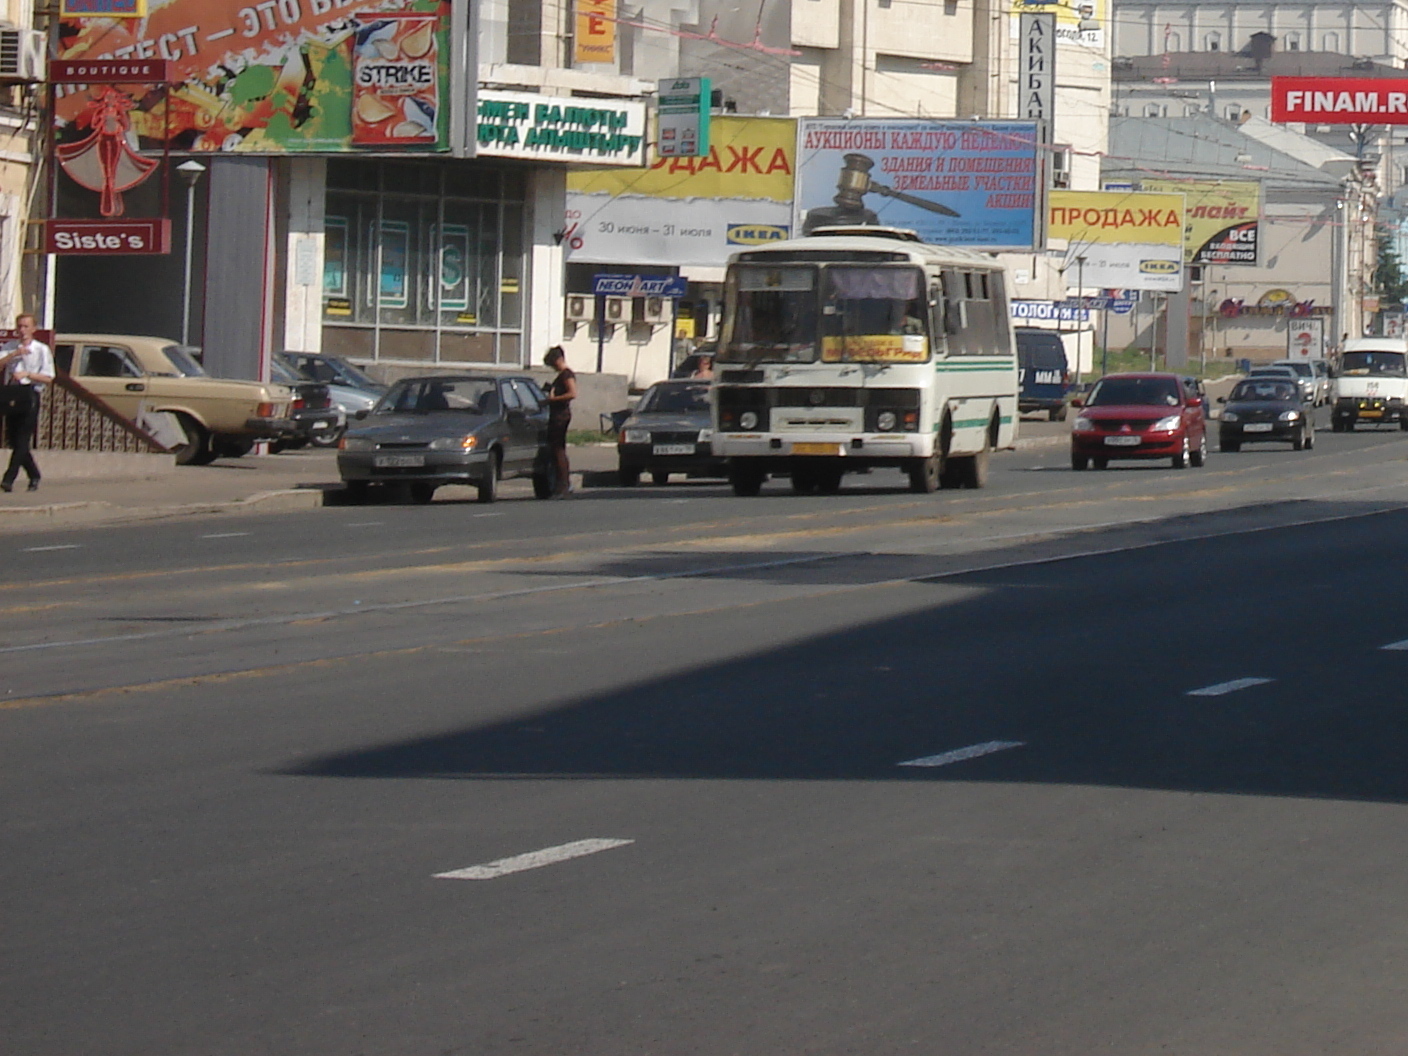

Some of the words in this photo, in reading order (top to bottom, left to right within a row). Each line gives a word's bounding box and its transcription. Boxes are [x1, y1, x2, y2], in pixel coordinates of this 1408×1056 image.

[66, 66, 150, 75] BOUTIQUE
[359, 65, 432, 87] STRIKE
[534, 104, 628, 128] ВАЛЮТЫ
[804, 130, 886, 150] АУКЦИОНЫ
[890, 131, 957, 151] КАЖДУЮ
[881, 156, 932, 174] ЗДАНИЯ
[935, 156, 946, 172] И
[893, 175, 970, 190] ЗЕМЕЛЬНЫЕ
[1050, 207, 1180, 229] ПРОДАЖА
[599, 222, 614, 233] 30
[617, 225, 649, 234] июня
[662, 224, 675, 236] 31
[679, 228, 712, 237] июля
[734, 229, 781, 240] IKEA
[1229, 229, 1256, 241] ВСЕ
[54, 231, 145, 251] Siste's
[1200, 251, 1256, 260] БЕСПЛАТНО
[596, 278, 634, 292] NEON
[640, 279, 672, 293] ART
